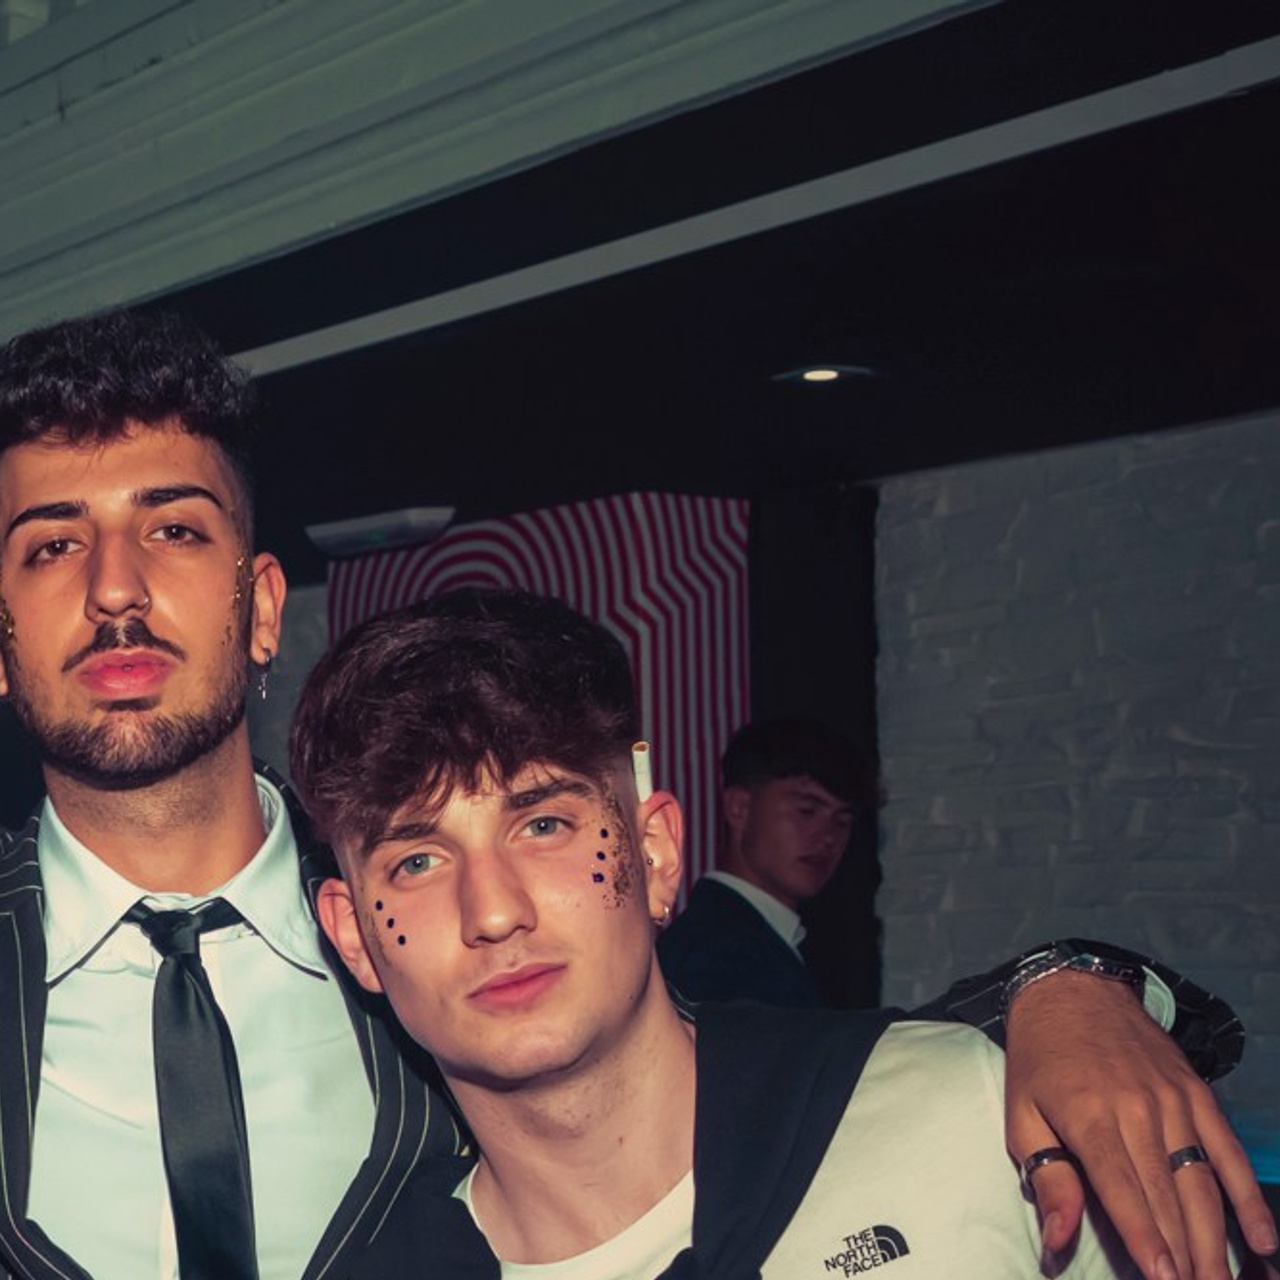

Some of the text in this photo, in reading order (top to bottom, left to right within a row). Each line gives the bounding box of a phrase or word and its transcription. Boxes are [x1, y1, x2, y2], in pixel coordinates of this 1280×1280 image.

[842, 1227, 874, 1249] THE
[824, 1240, 879, 1272] NORTH
[843, 1255, 883, 1279] FACE
